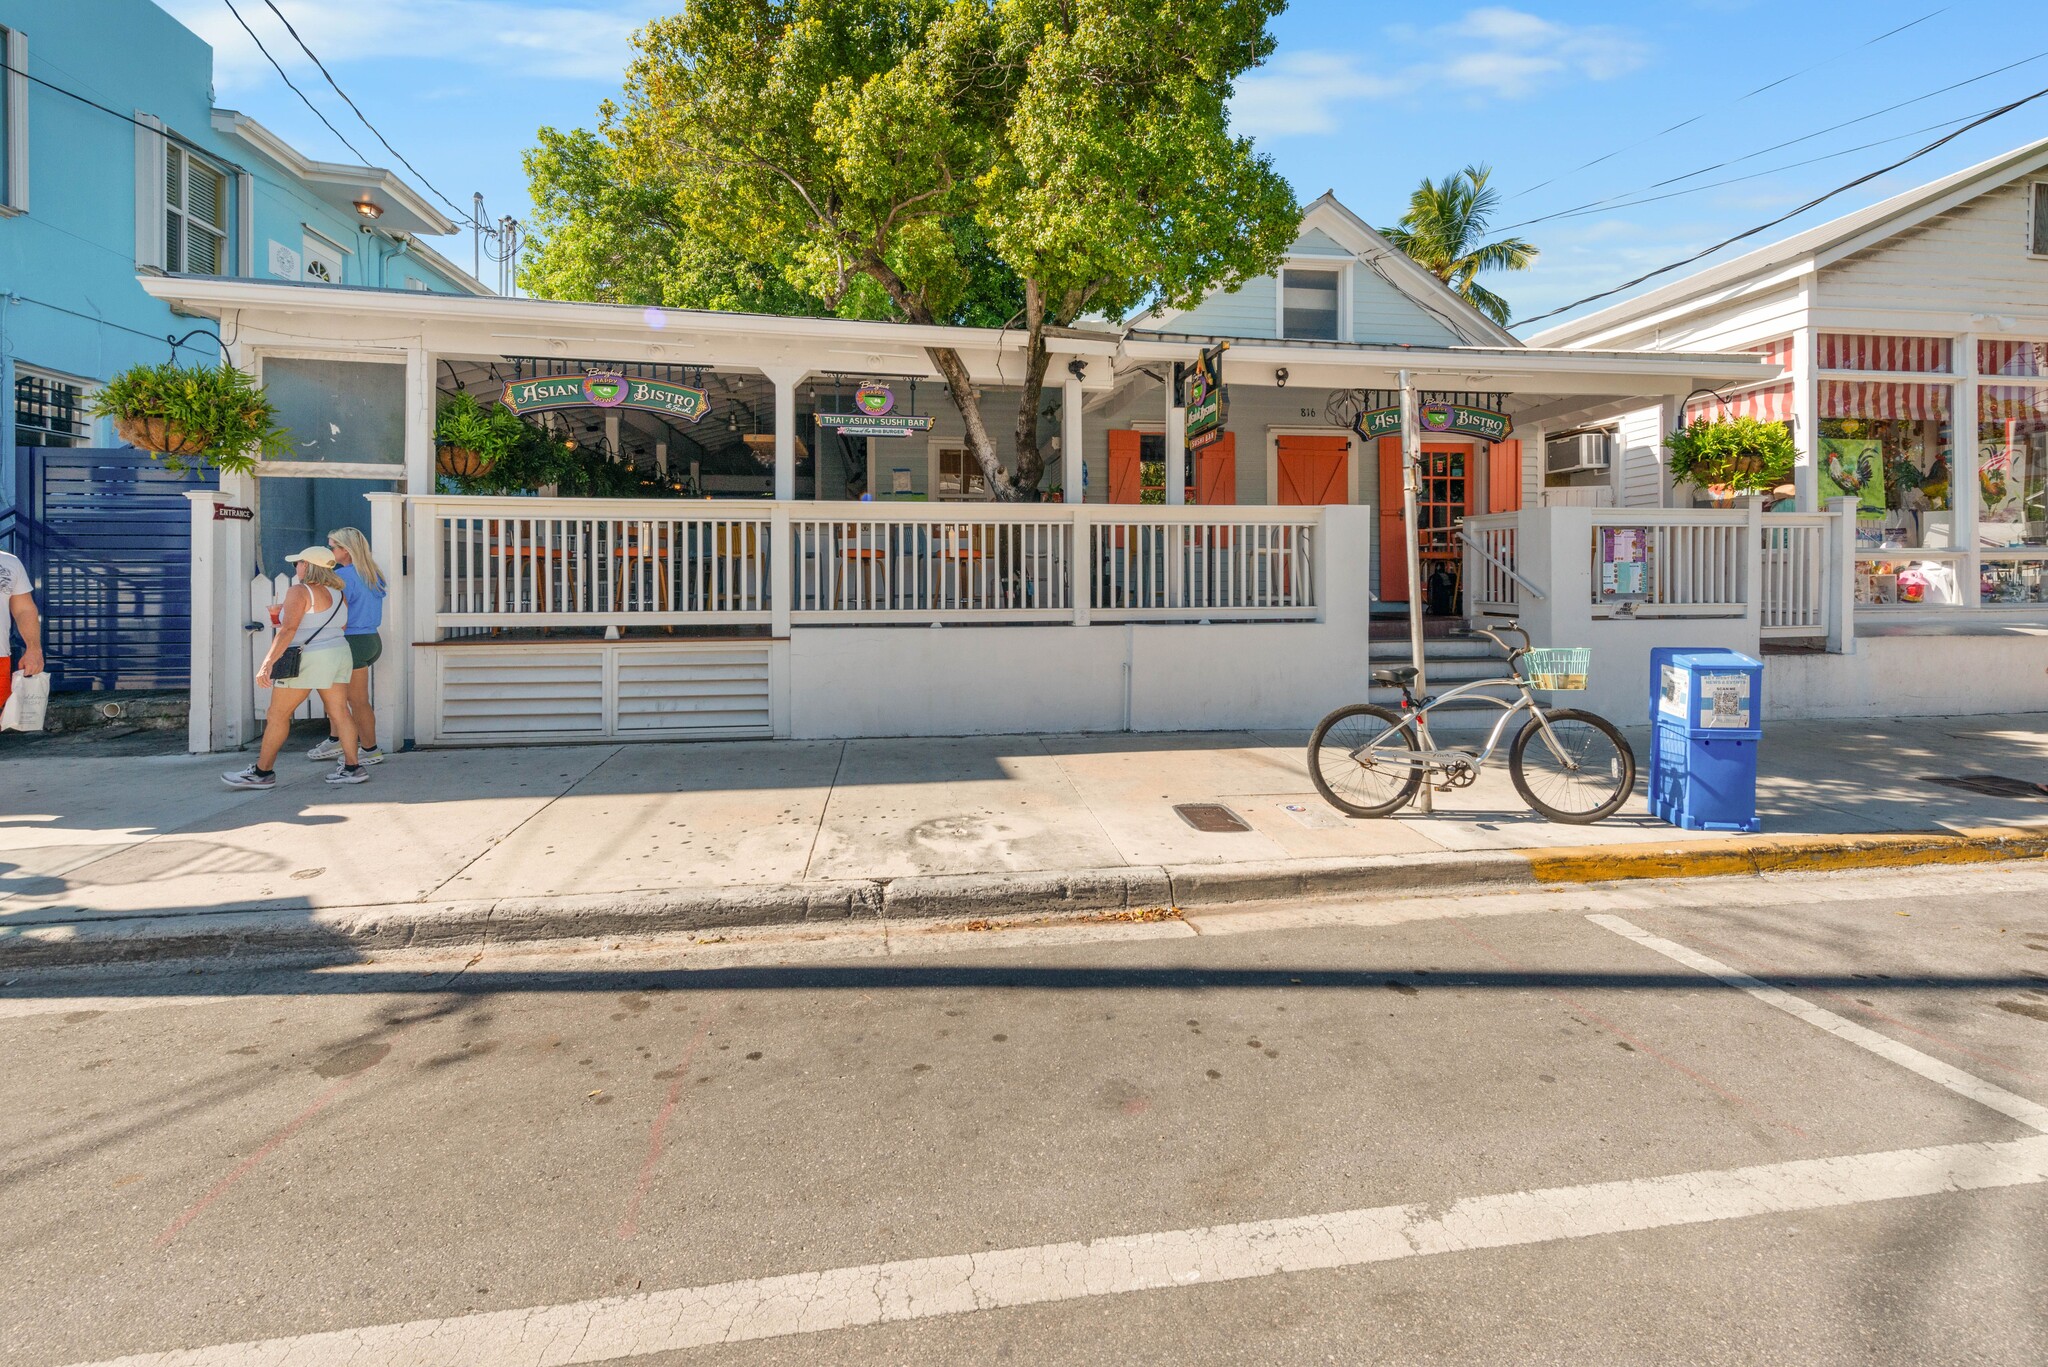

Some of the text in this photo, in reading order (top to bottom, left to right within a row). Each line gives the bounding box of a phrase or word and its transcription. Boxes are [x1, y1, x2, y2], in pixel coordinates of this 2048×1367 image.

[1300, 407, 1316, 418] 816
[824, 416, 844, 424] THAI
[849, 417, 875, 425] ASIAN
[880, 418, 906, 426] SUSHI
[219, 508, 251, 517] ENTRANCE
